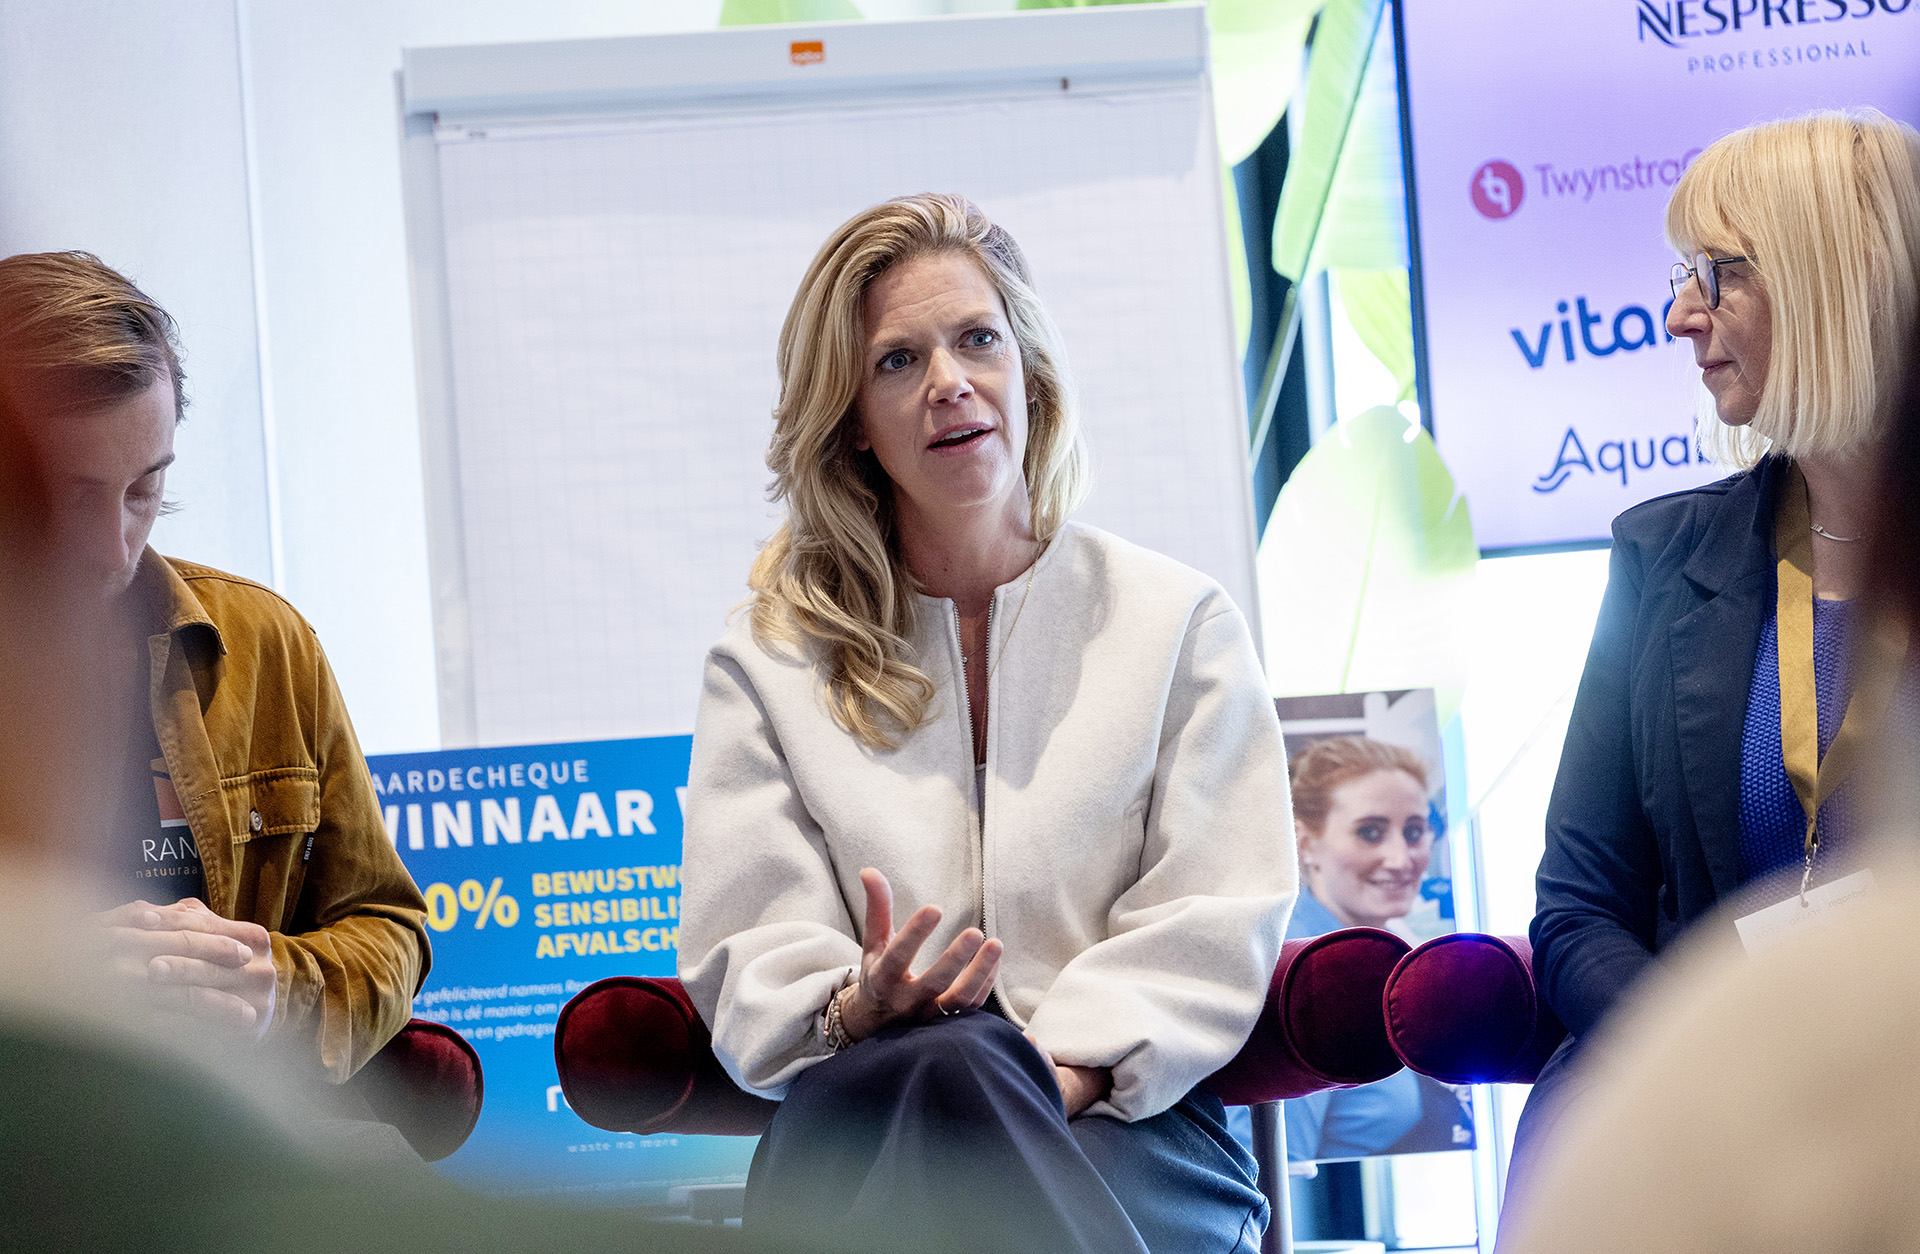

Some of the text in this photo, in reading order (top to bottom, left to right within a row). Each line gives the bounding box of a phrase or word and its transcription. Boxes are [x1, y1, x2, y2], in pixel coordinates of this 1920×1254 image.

[1687, 40, 1871, 75] PROFESSIONAL
[142, 836, 199, 862] RAN
[135, 865, 203, 879] natuuraa
[534, 896, 681, 928] SENSIBILI
[508, 983, 563, 997] namens
